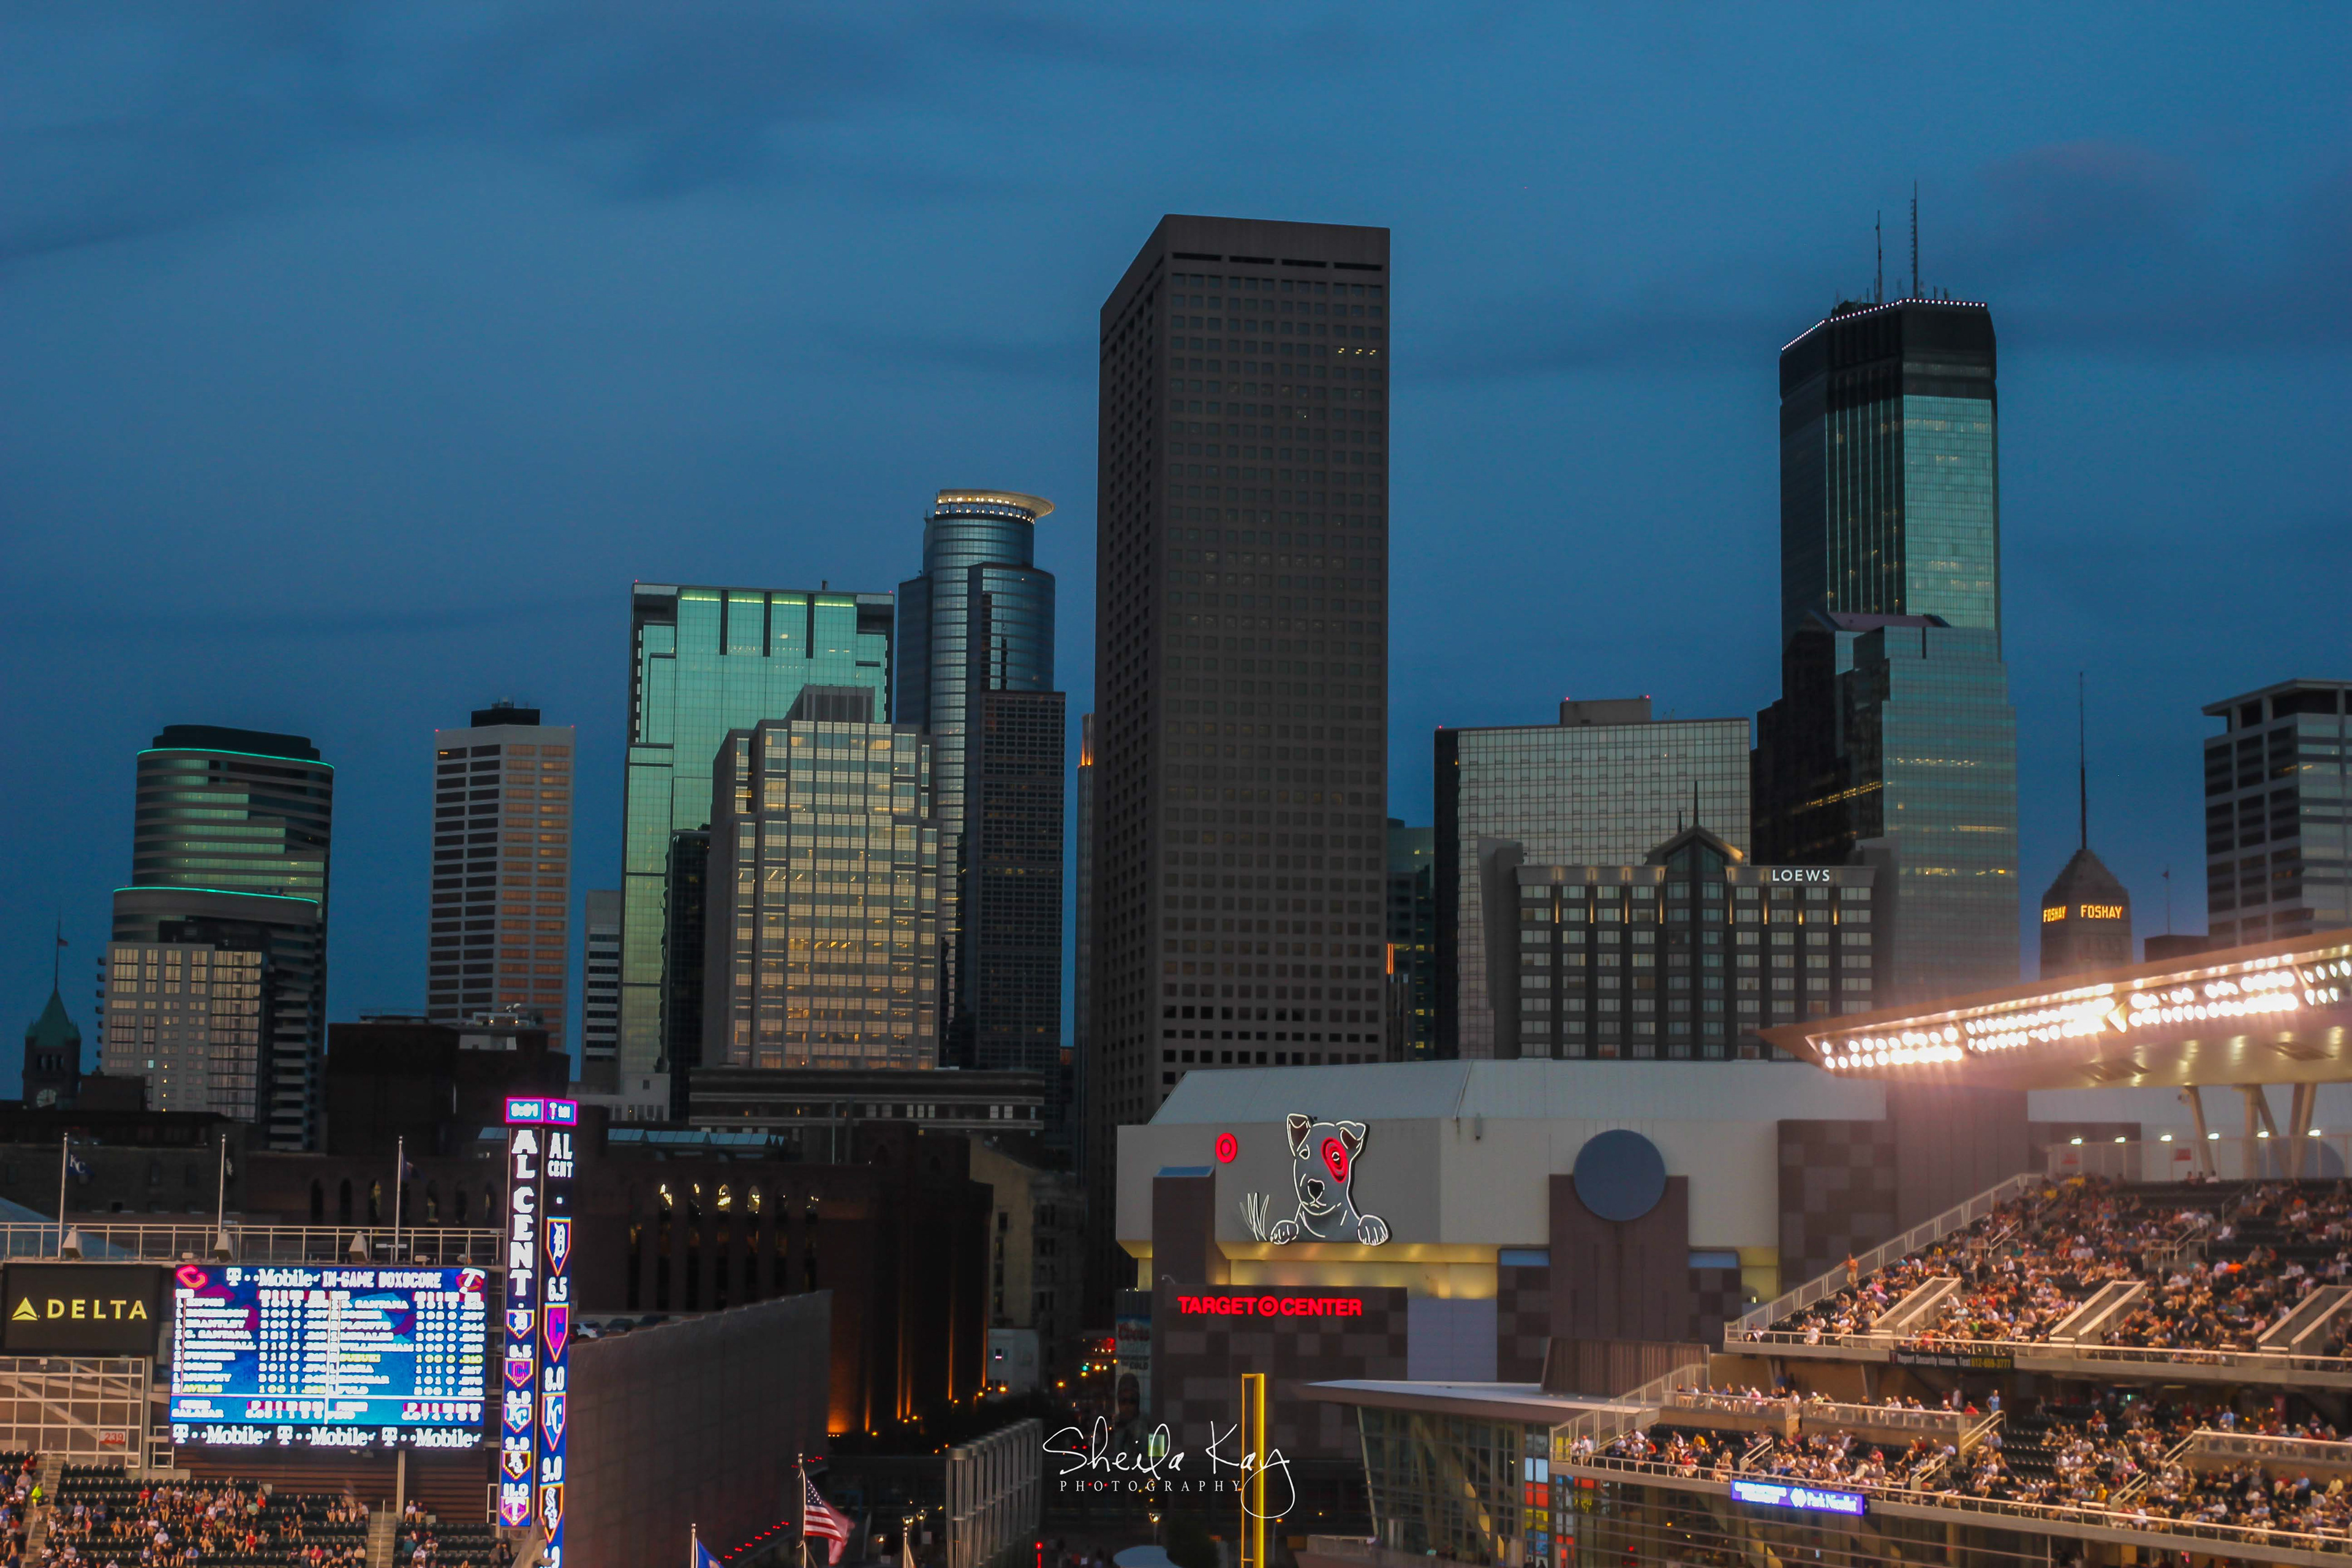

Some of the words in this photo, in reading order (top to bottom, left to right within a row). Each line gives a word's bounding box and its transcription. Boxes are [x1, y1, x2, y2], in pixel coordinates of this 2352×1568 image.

[1773, 869, 1830, 881] LOEWS
[2043, 905, 2067, 922] FOSHAY
[2081, 905, 2122, 919] FOSHAY
[549, 1133, 573, 1159] AL
[548, 1160, 573, 1177] CENT
[323, 1271, 374, 1287] IN-GAME
[379, 1272, 442, 1288] BOXSCORE
[548, 1277, 567, 1302] 6.5
[47, 1298, 148, 1320] DELTA
[1177, 1295, 1258, 1315] TARGET
[1280, 1297, 1362, 1316] CENTER
[1915, 1354, 1937, 1367] Security
[545, 1366, 565, 1392] 8.0
[104, 1432, 124, 1442] 239
[542, 1456, 562, 1482] 9.0
[1807, 1491, 1826, 1508] Park
